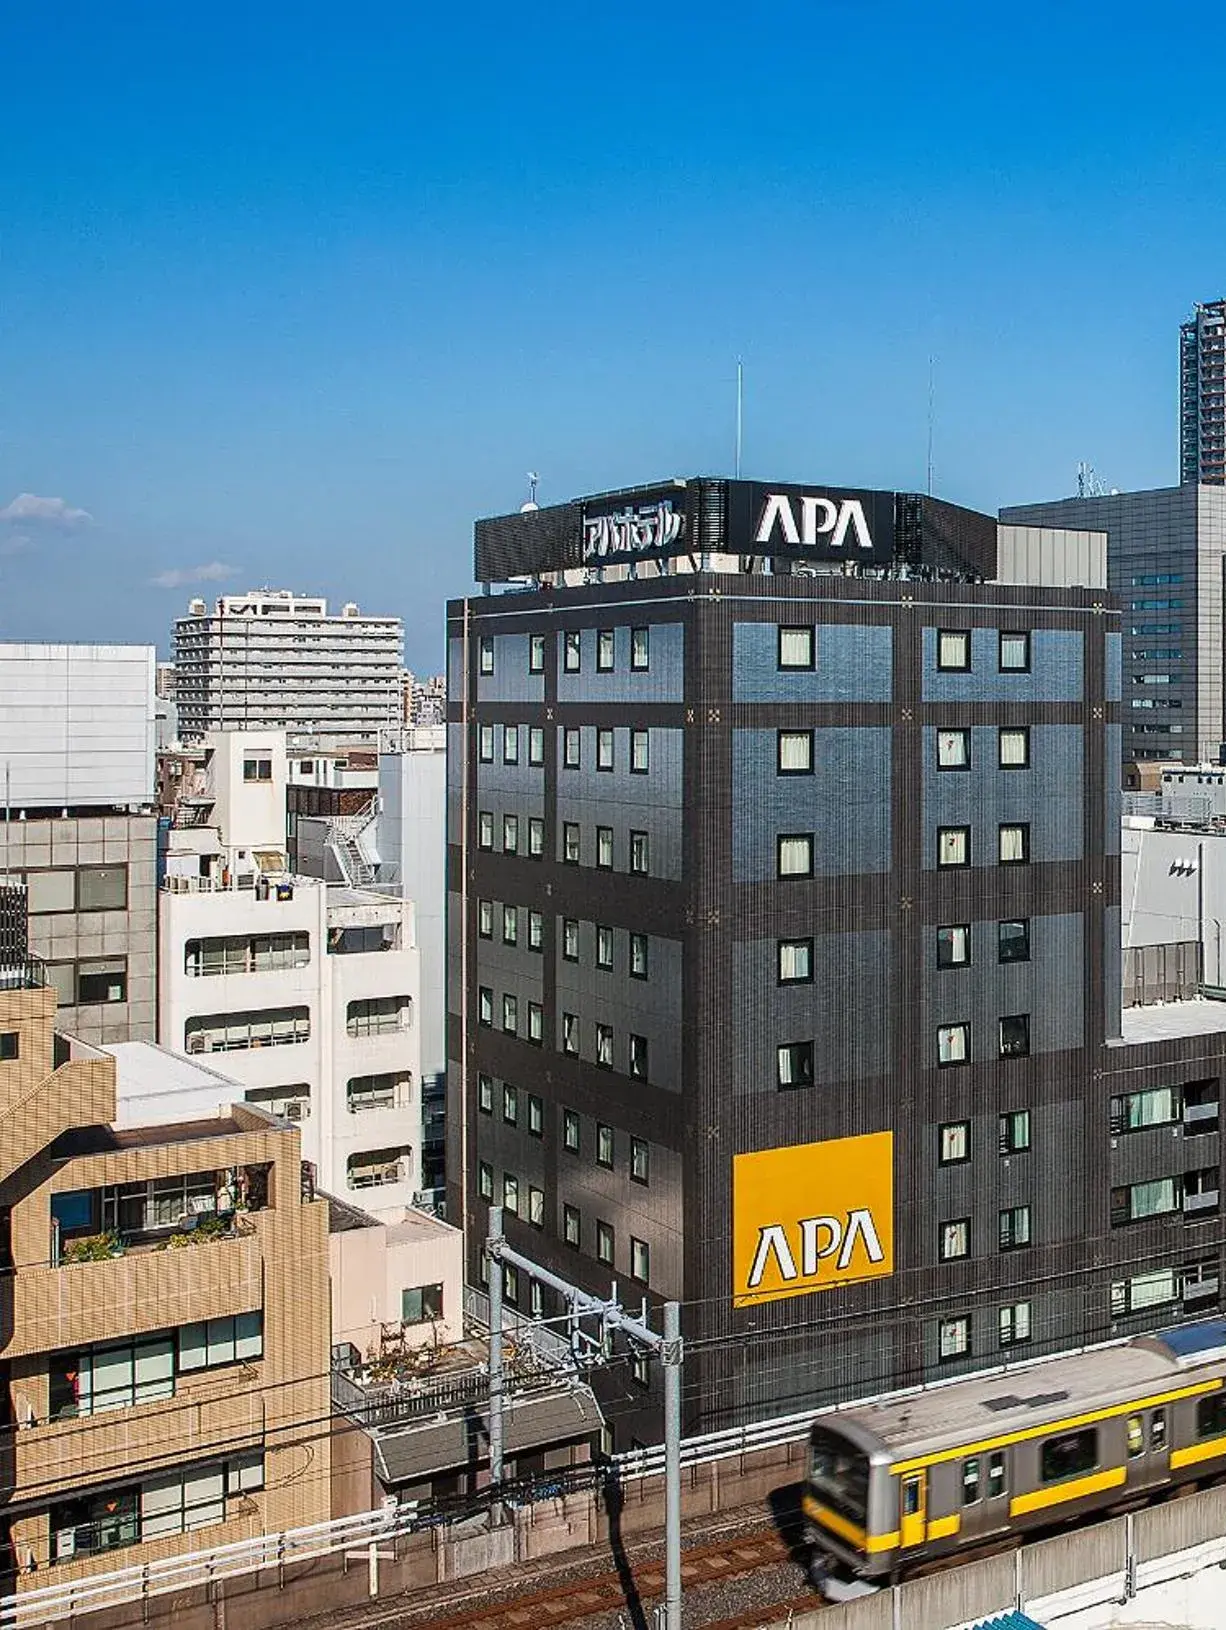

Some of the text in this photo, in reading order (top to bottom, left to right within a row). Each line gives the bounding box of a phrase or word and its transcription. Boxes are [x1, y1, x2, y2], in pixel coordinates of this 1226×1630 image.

[584, 499, 682, 557] アパホテル
[756, 494, 873, 548] APA
[748, 1208, 885, 1288] APA
